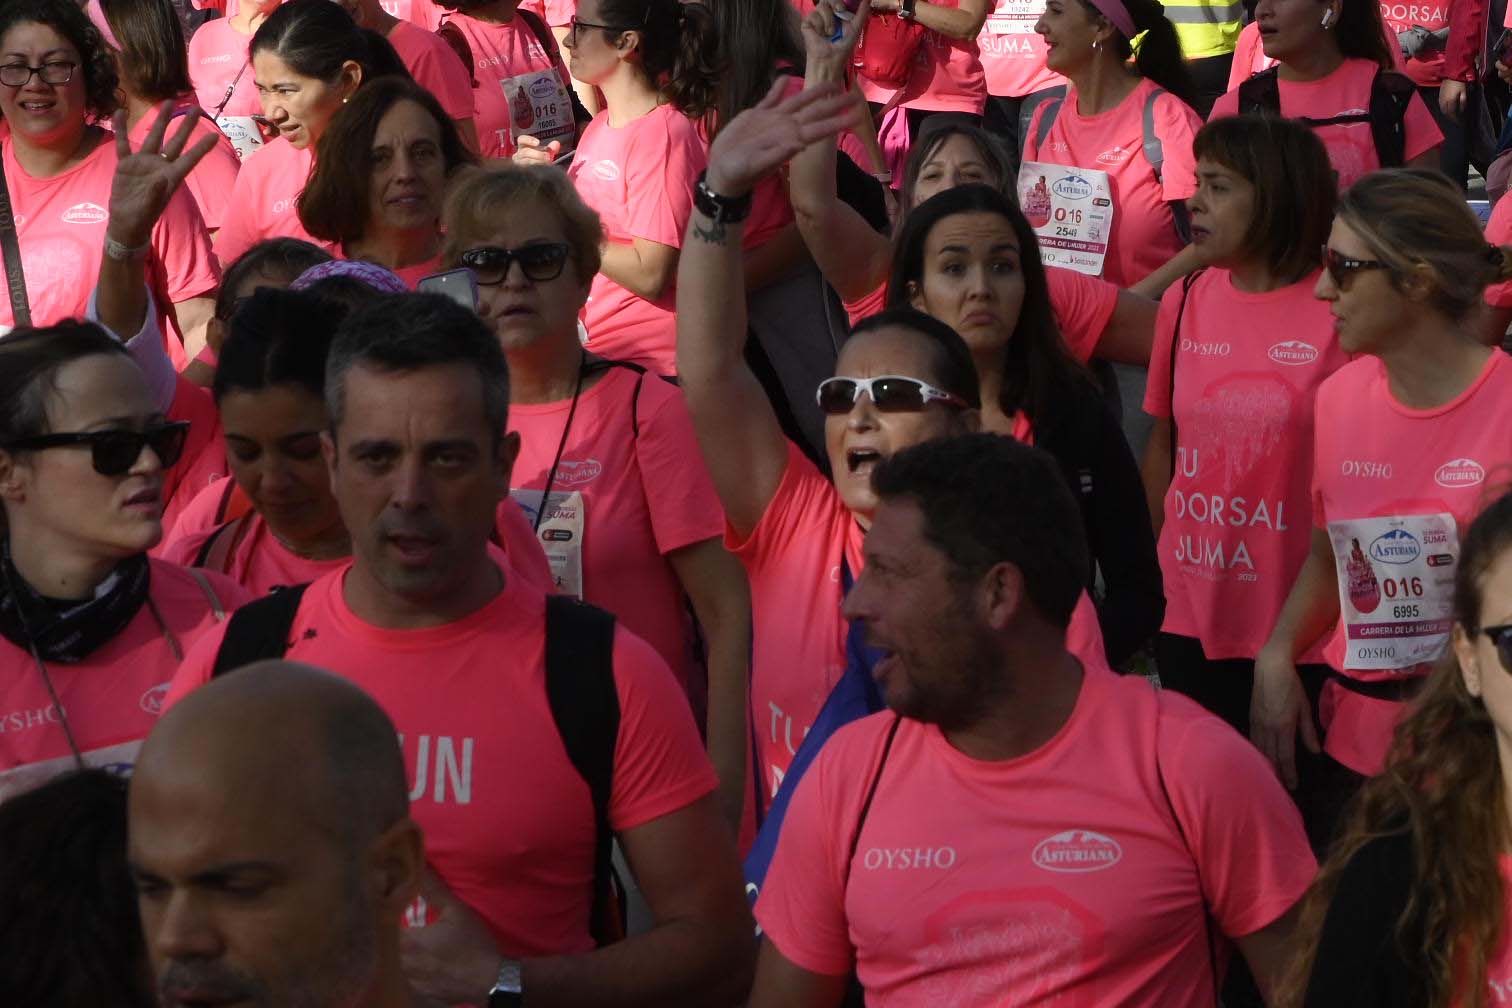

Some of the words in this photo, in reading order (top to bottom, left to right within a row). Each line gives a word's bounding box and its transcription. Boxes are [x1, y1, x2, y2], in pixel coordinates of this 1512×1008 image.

[982, 36, 1033, 53] SUMA
[535, 103, 557, 118] 016
[1054, 207, 1082, 224] 016
[1181, 338, 1230, 356] OYSHO
[1342, 459, 1392, 479] OYSHO
[547, 511, 576, 520] SUMA
[1175, 489, 1289, 531] DORSAL
[1423, 535, 1447, 545] SUMA
[1175, 535, 1254, 569] SUMA
[1383, 576, 1424, 598] 016
[1393, 604, 1419, 618] 6995
[1358, 646, 1396, 659] OYSHO
[864, 846, 956, 870] OYSHO
[1039, 845, 1114, 863] ASTURIANA
